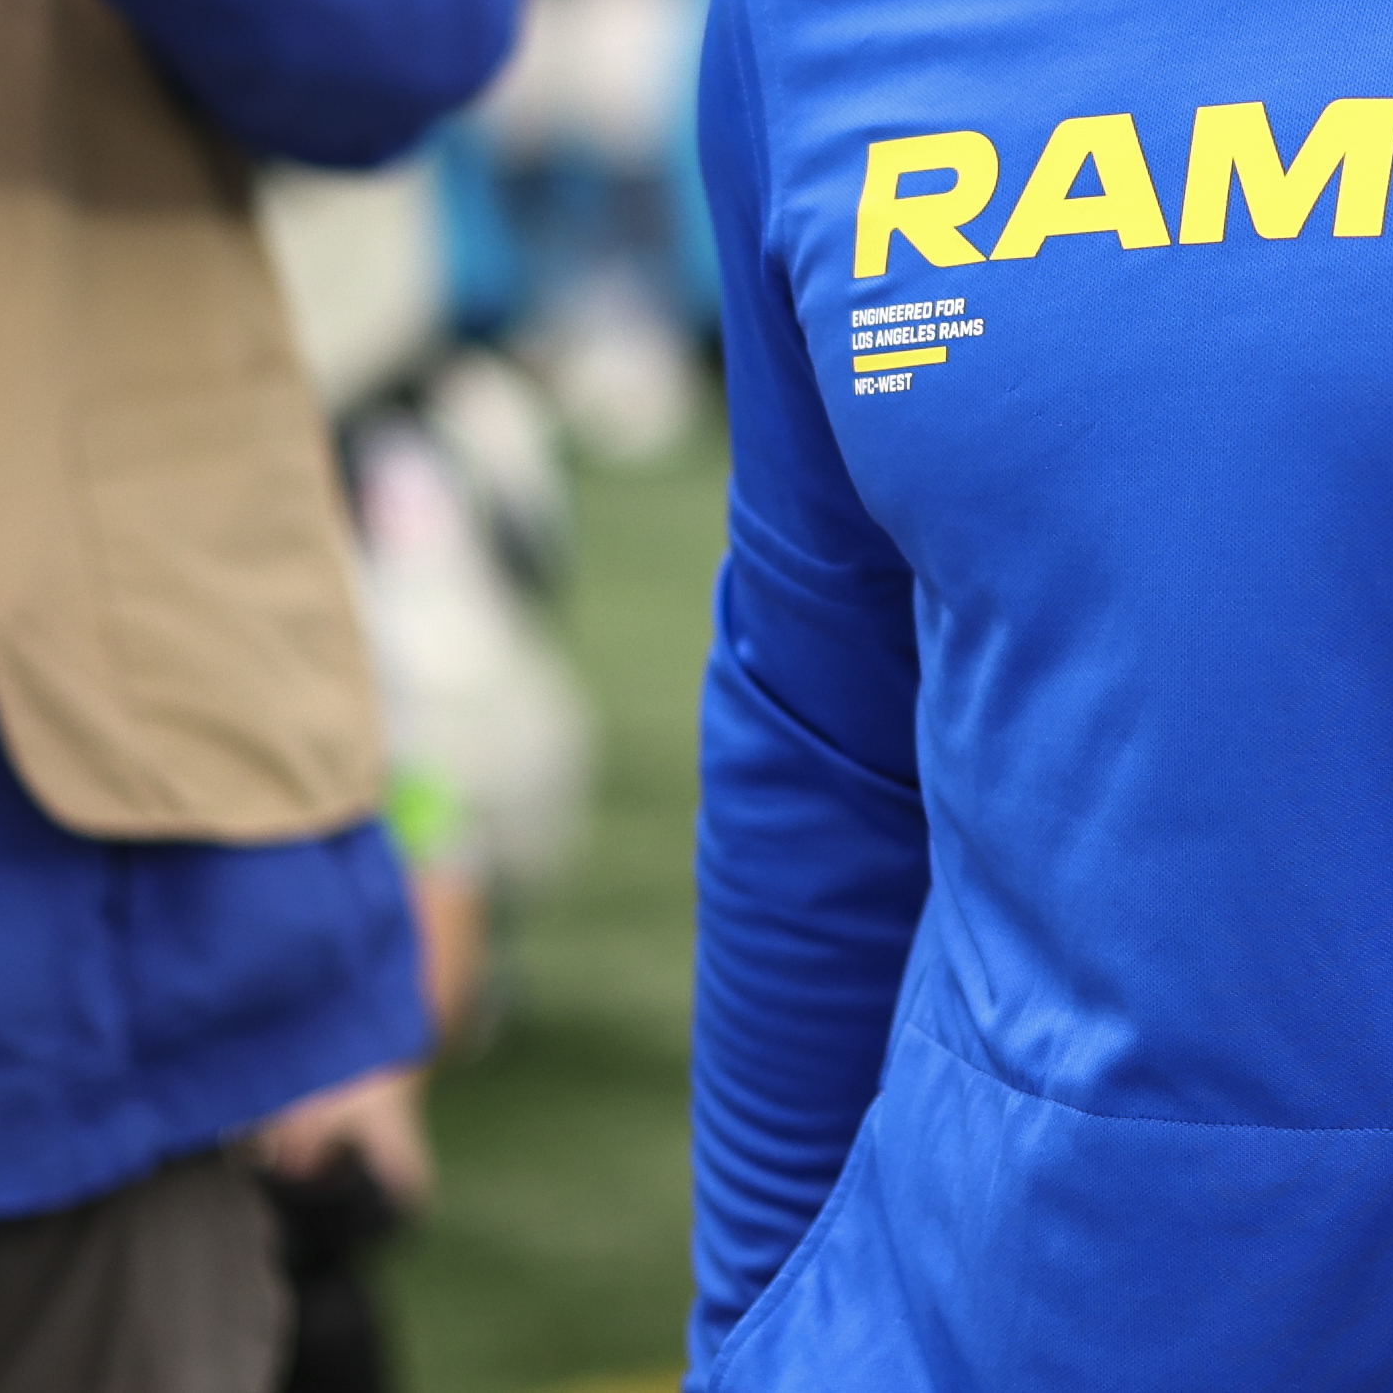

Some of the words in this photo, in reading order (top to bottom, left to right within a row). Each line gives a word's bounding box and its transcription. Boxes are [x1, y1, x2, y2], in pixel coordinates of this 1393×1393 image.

[852, 301, 933, 328] ENGINEERED
[935, 297, 965, 317] FOR
[852, 331, 874, 351] LOS
[875, 323, 937, 348] ANGELES
[939, 318, 985, 340] RAMS
[854, 372, 913, 396] NFC-WEST
